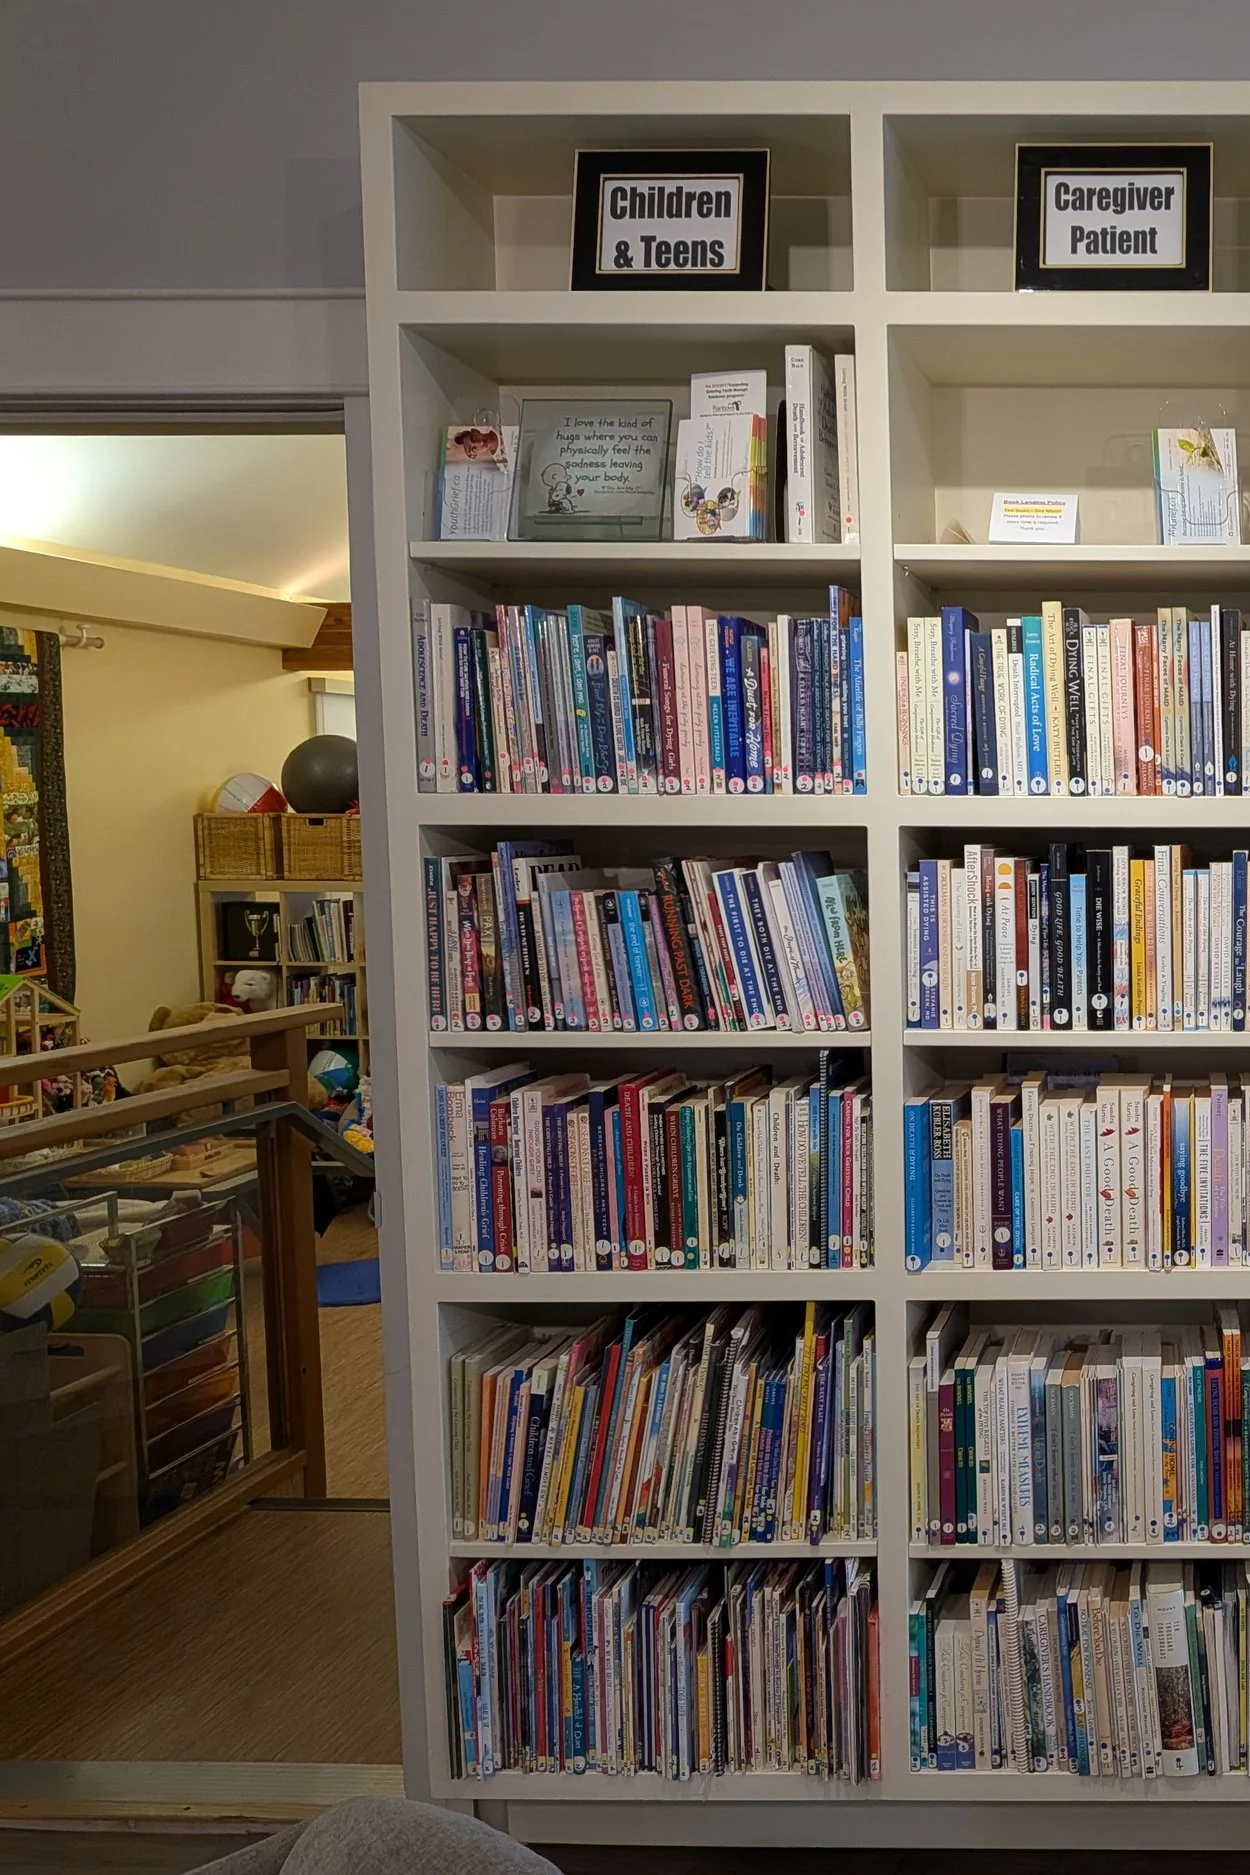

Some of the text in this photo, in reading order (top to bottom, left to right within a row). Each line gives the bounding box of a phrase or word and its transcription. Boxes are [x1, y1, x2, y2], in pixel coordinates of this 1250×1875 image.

[609, 186, 732, 219] Children
[1054, 182, 1175, 214] Caregiver
[613, 235, 725, 269] & Teens
[1070, 225, 1158, 255] Patient
[564, 418, 654, 427] I love the kind of
[556, 432, 658, 444] hugs where you can
[560, 445, 651, 457] physically feel the
[565, 460, 643, 471] sadness leaving
[575, 473, 630, 484] your body.
[1048, 632, 1056, 645] Art
[1049, 647, 1056, 655] of
[662, 663, 671, 690] Funeral
[1048, 657, 1058, 685] Dying
[1066, 639, 1081, 712] DYING WELL
[664, 692, 673, 712] Songs
[1051, 687, 1059, 702] Well
[665, 715, 673, 725] for
[1052, 716, 1060, 739] KATY
[665, 728, 674, 750] Dying
[967, 851, 977, 905] AfterShock
[1158, 850, 1168, 944] Final Conversations
[483, 916, 492, 936] PAX
[662, 895, 693, 1008] RUNNING PAST DARK
[1074, 934, 1082, 950] Help
[1075, 970, 1083, 995] Parents
[942, 1105, 950, 1159] ELISABETH
[1128, 1141, 1139, 1234] A Good Death
[496, 1170, 507, 1252] Parenting through Crisis
[524, 1416, 539, 1496] Children and Grief
[1017, 1407, 1030, 1507] EXTREME MEASURES
[1038, 1614, 1054, 1728] CAREGIVER'S HANDBOOK
